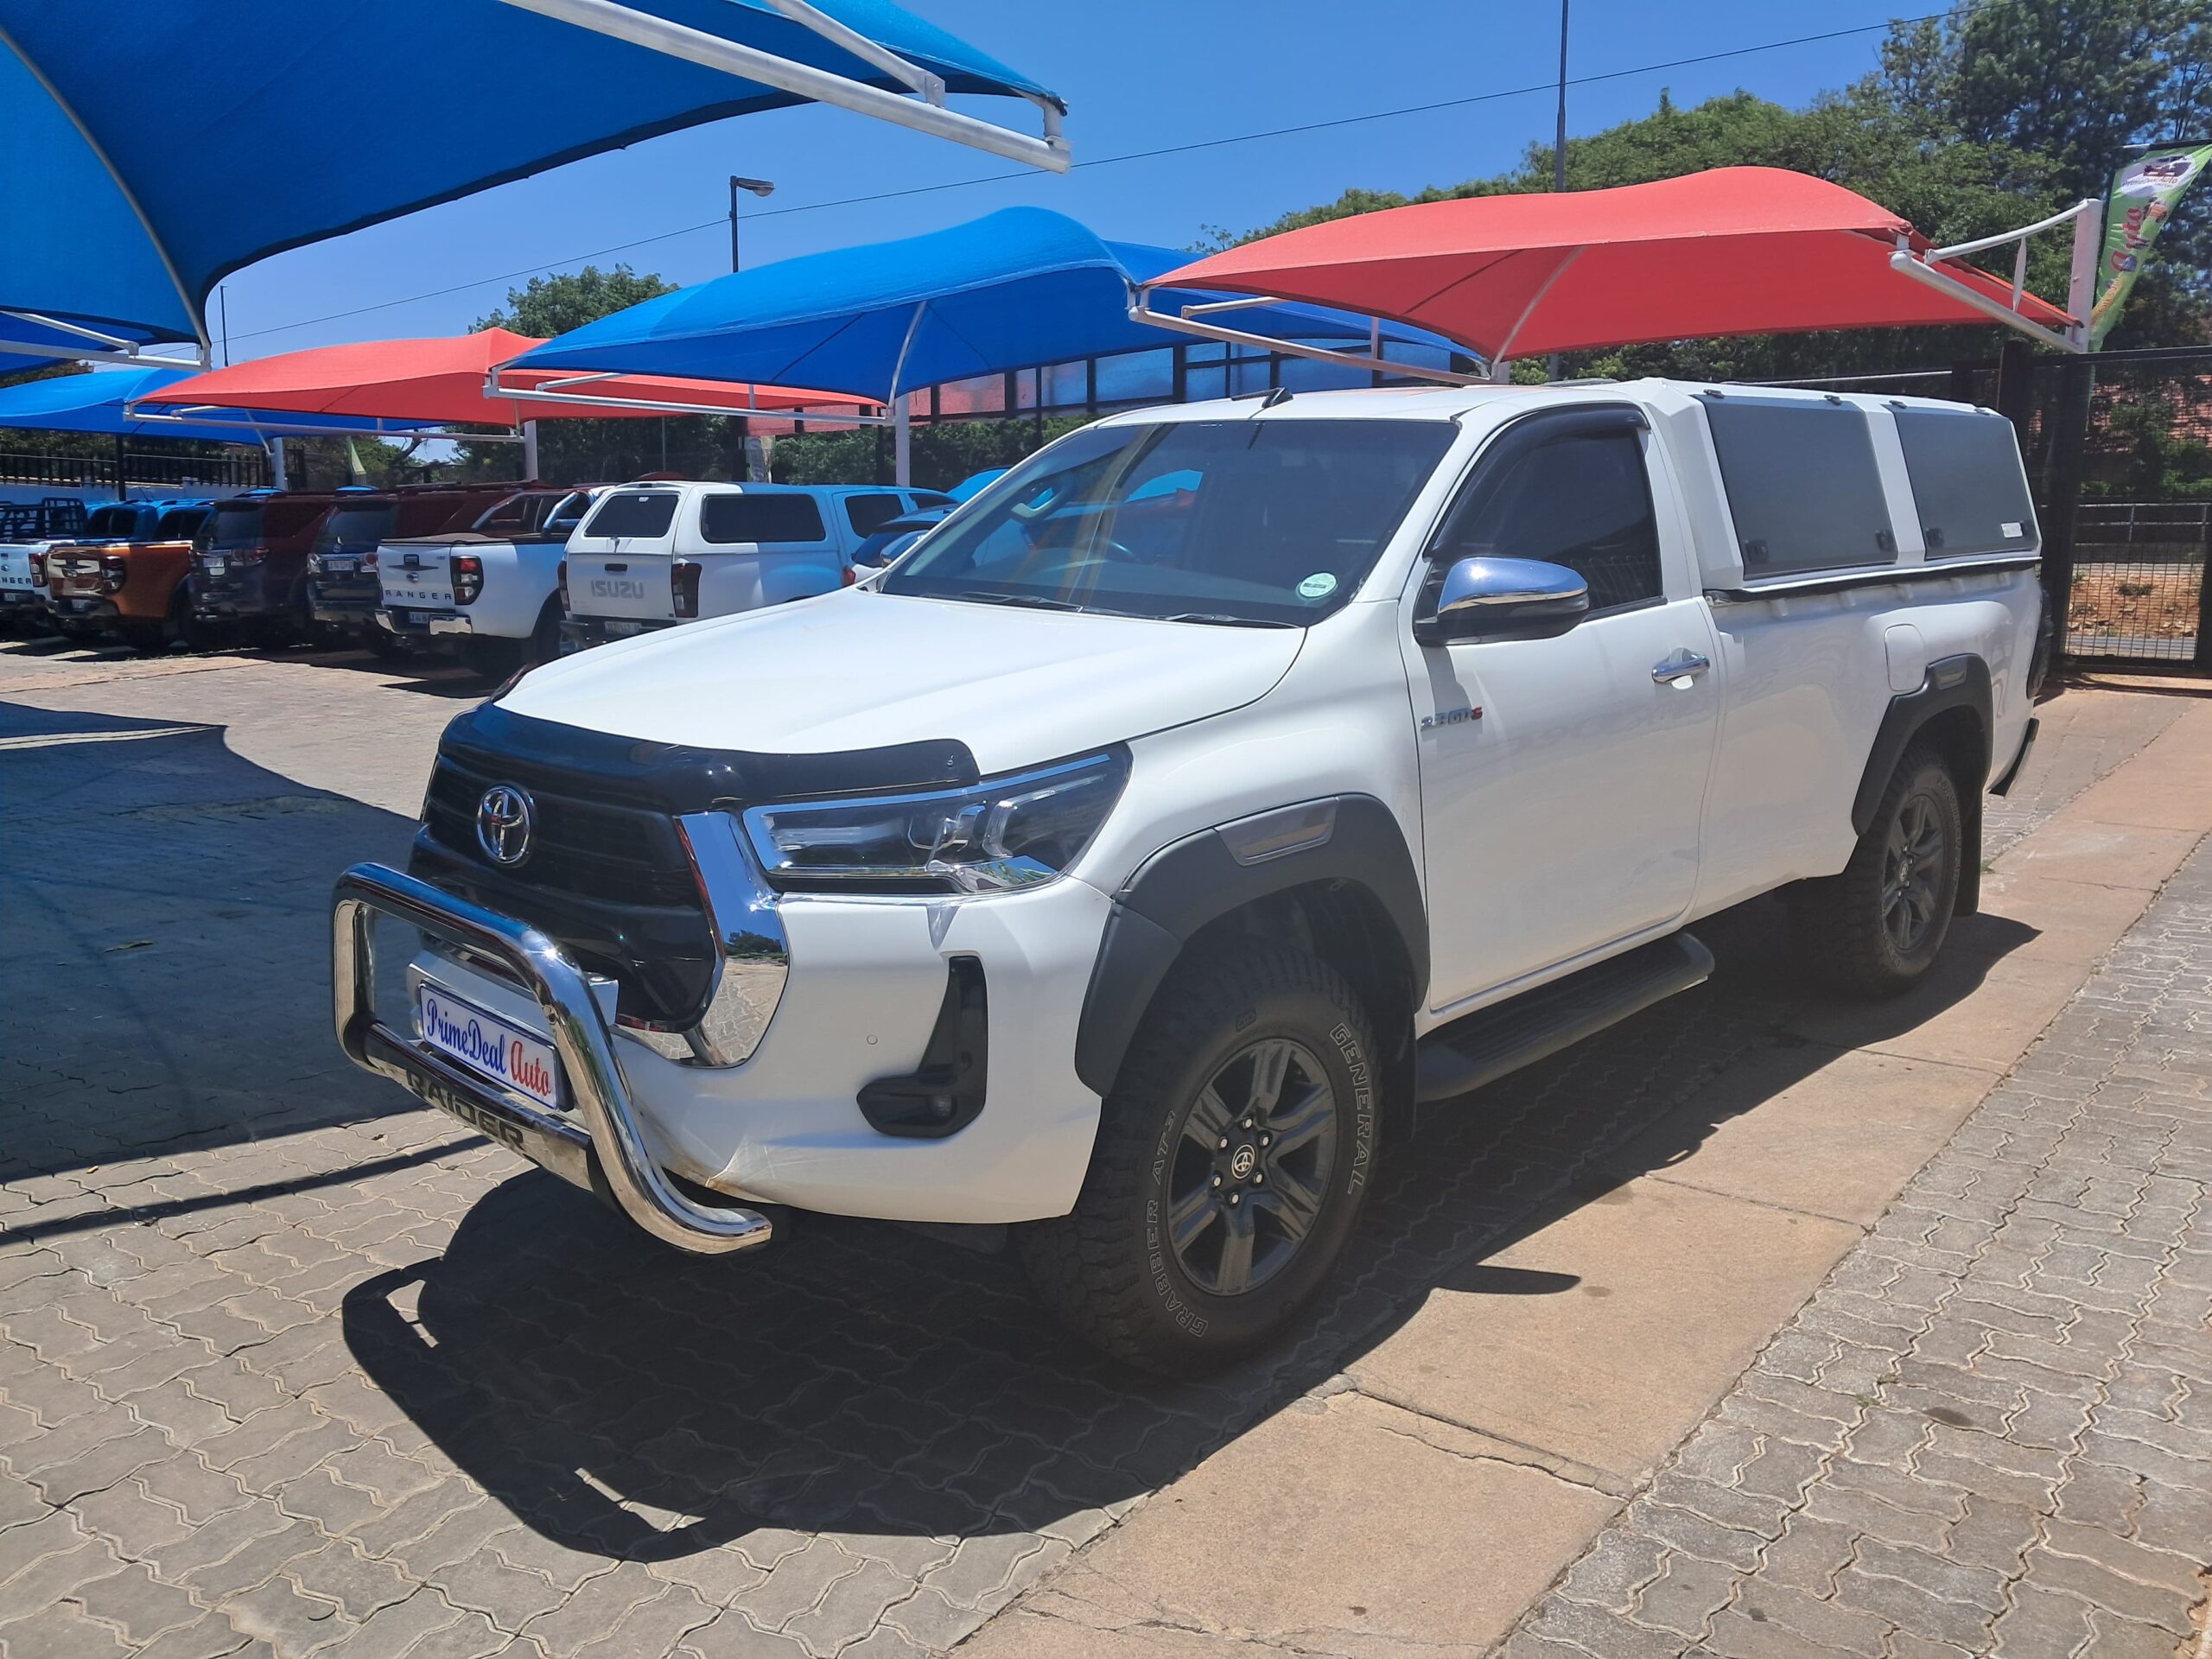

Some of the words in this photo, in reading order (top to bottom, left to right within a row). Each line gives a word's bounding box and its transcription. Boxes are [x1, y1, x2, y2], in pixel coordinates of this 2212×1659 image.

[385, 589, 452, 600] RANGER
[591, 581, 644, 599] ISUZU
[427, 998, 506, 1074] PrimeDeal
[510, 1040, 551, 1096] Auto
[406, 1069, 524, 1151] RAIDER
[1329, 1022, 1371, 1195] GENERAL
[1146, 1198, 1208, 1338] GRABBER
